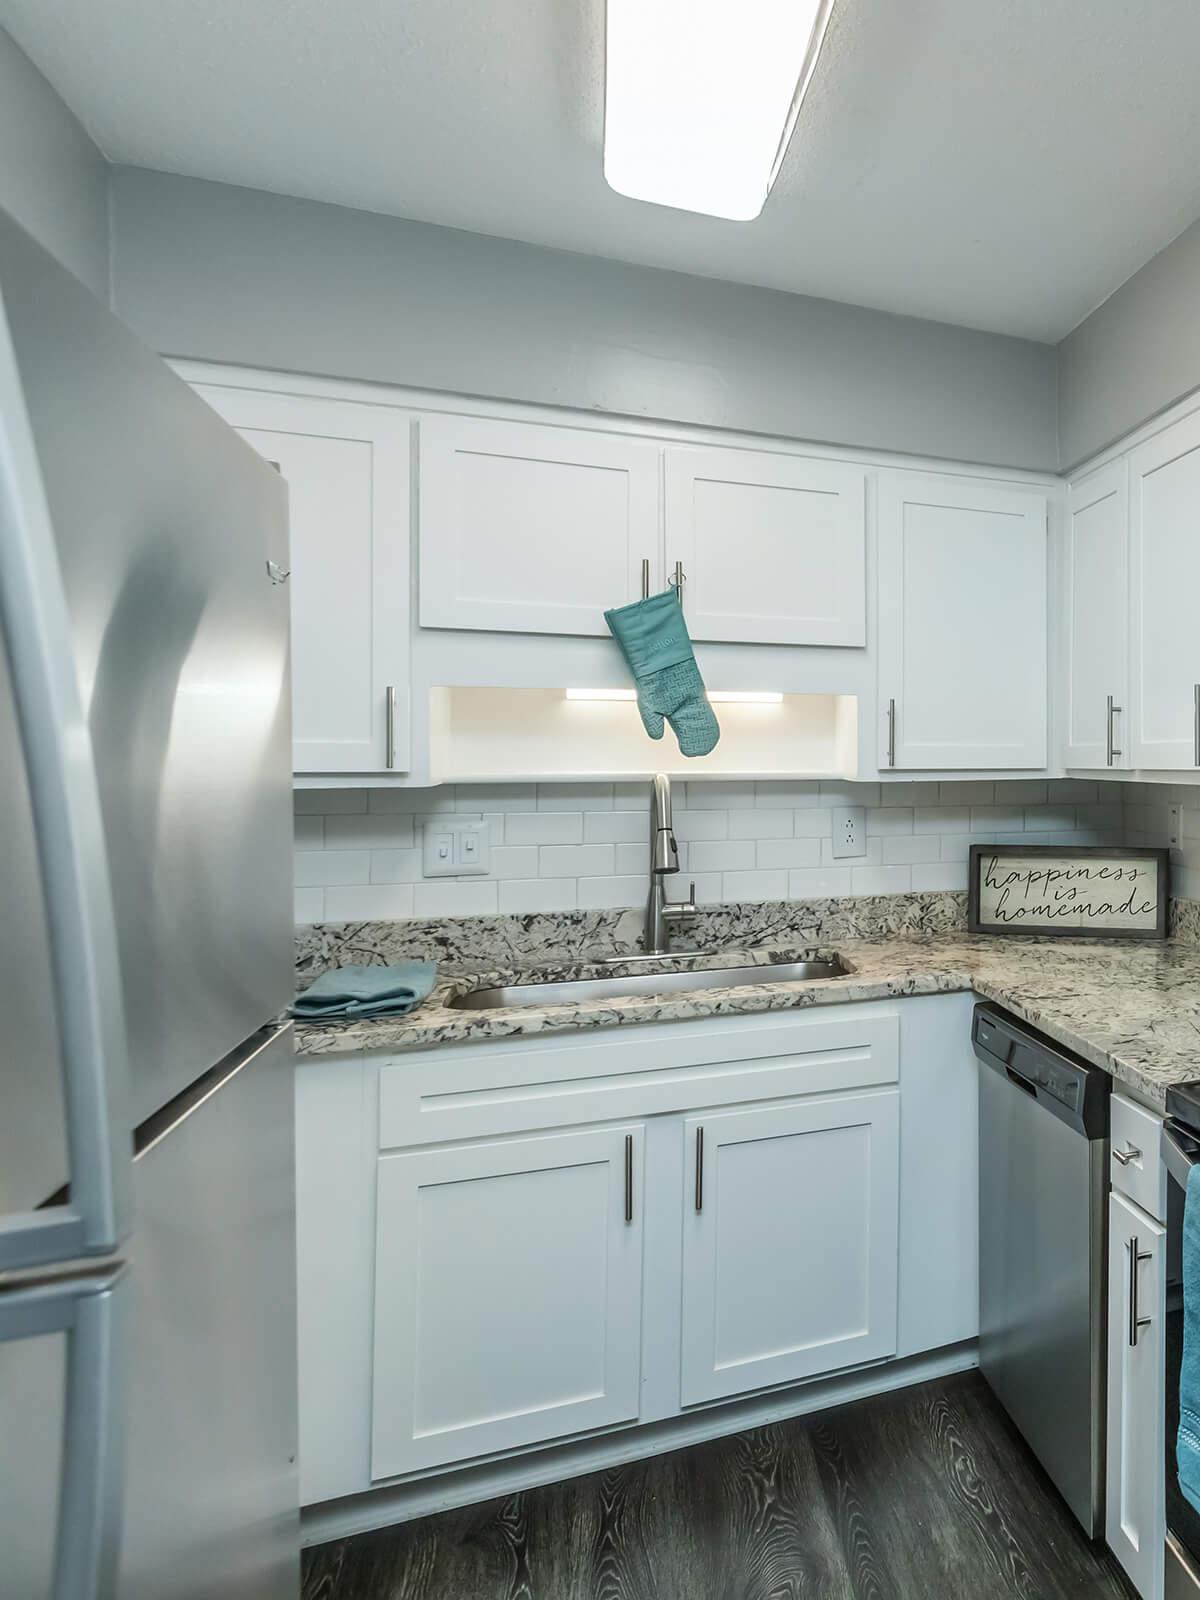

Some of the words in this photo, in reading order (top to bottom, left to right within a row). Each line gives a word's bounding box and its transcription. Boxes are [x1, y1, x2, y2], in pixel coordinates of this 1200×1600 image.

[984, 855, 1147, 898] happiness
[1053, 885, 1089, 901] is
[993, 887, 1159, 922] homemade
